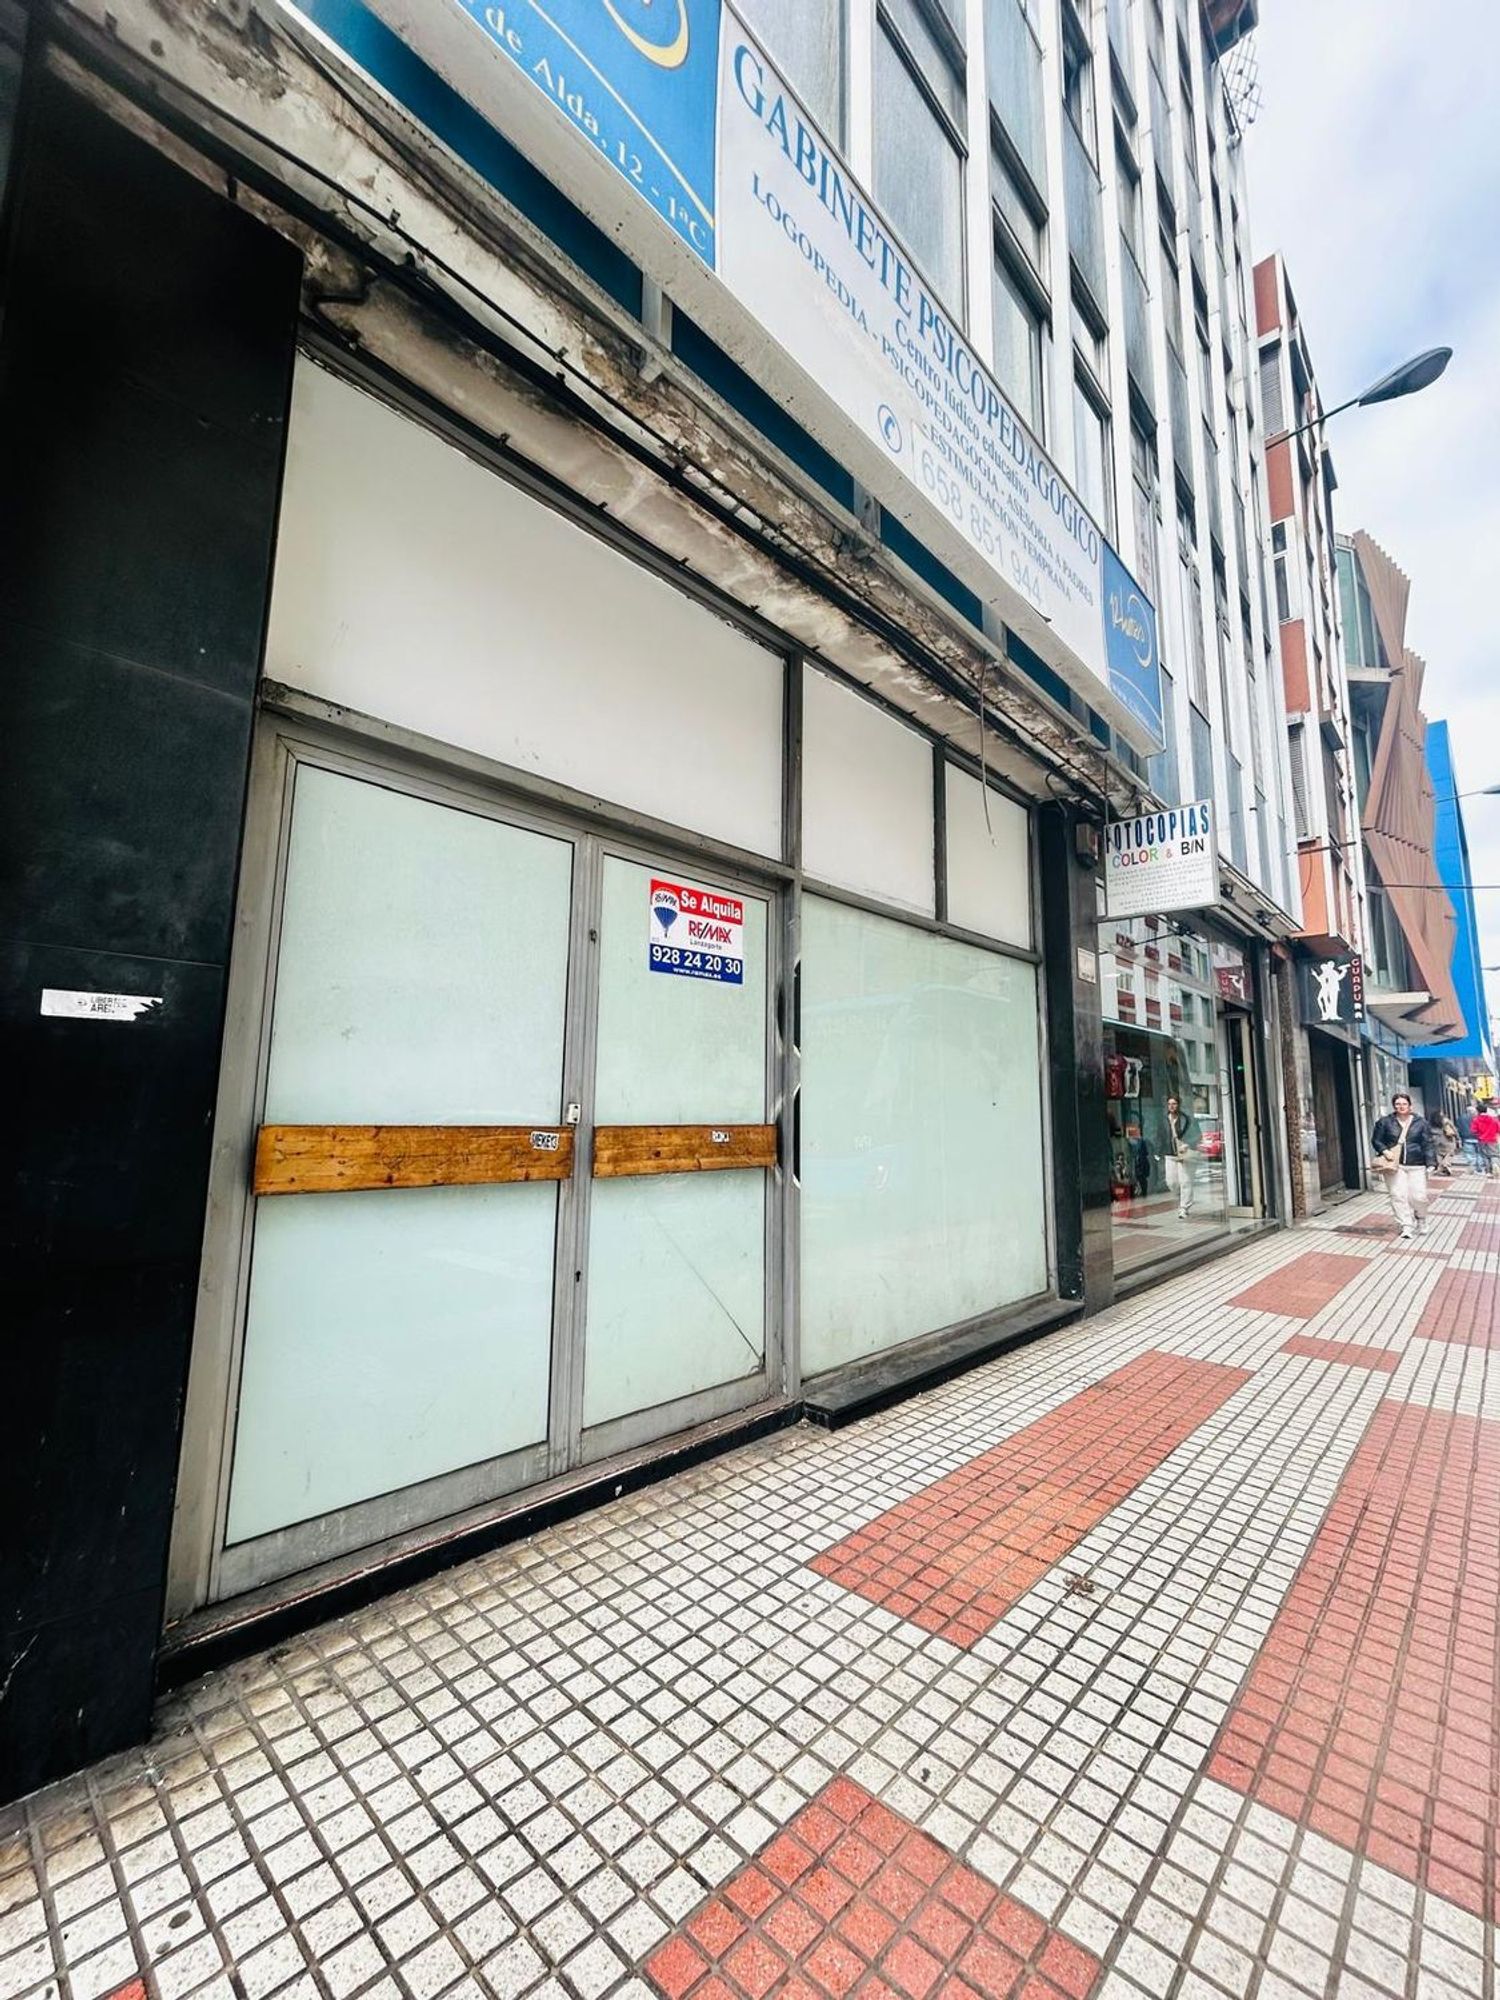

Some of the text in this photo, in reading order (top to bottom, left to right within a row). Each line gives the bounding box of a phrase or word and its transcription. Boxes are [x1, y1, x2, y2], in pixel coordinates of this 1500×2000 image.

[485, 8, 522, 54] de
[533, 58, 607, 150] Alda,
[618, 141, 644, 184] 12
[734, 45, 1098, 566] GABINETE PSICOPEDAGOGICO
[753, 173, 868, 330] LOGOPEDIA
[881, 337, 999, 494] PSICOPEDAGOGIA
[895, 318, 940, 392] Centro
[982, 431, 1029, 503] educativo
[921, 450, 1042, 604] 658 851 944
[1106, 804, 1210, 853] FOTOCOPIAS
[1112, 848, 1160, 868] COLOR
[1181, 838, 1205, 856] B/N
[681, 890, 741, 919] Se Alquila
[688, 919, 732, 944] RE/MAX
[652, 946, 740, 974] 928 24 20 30
